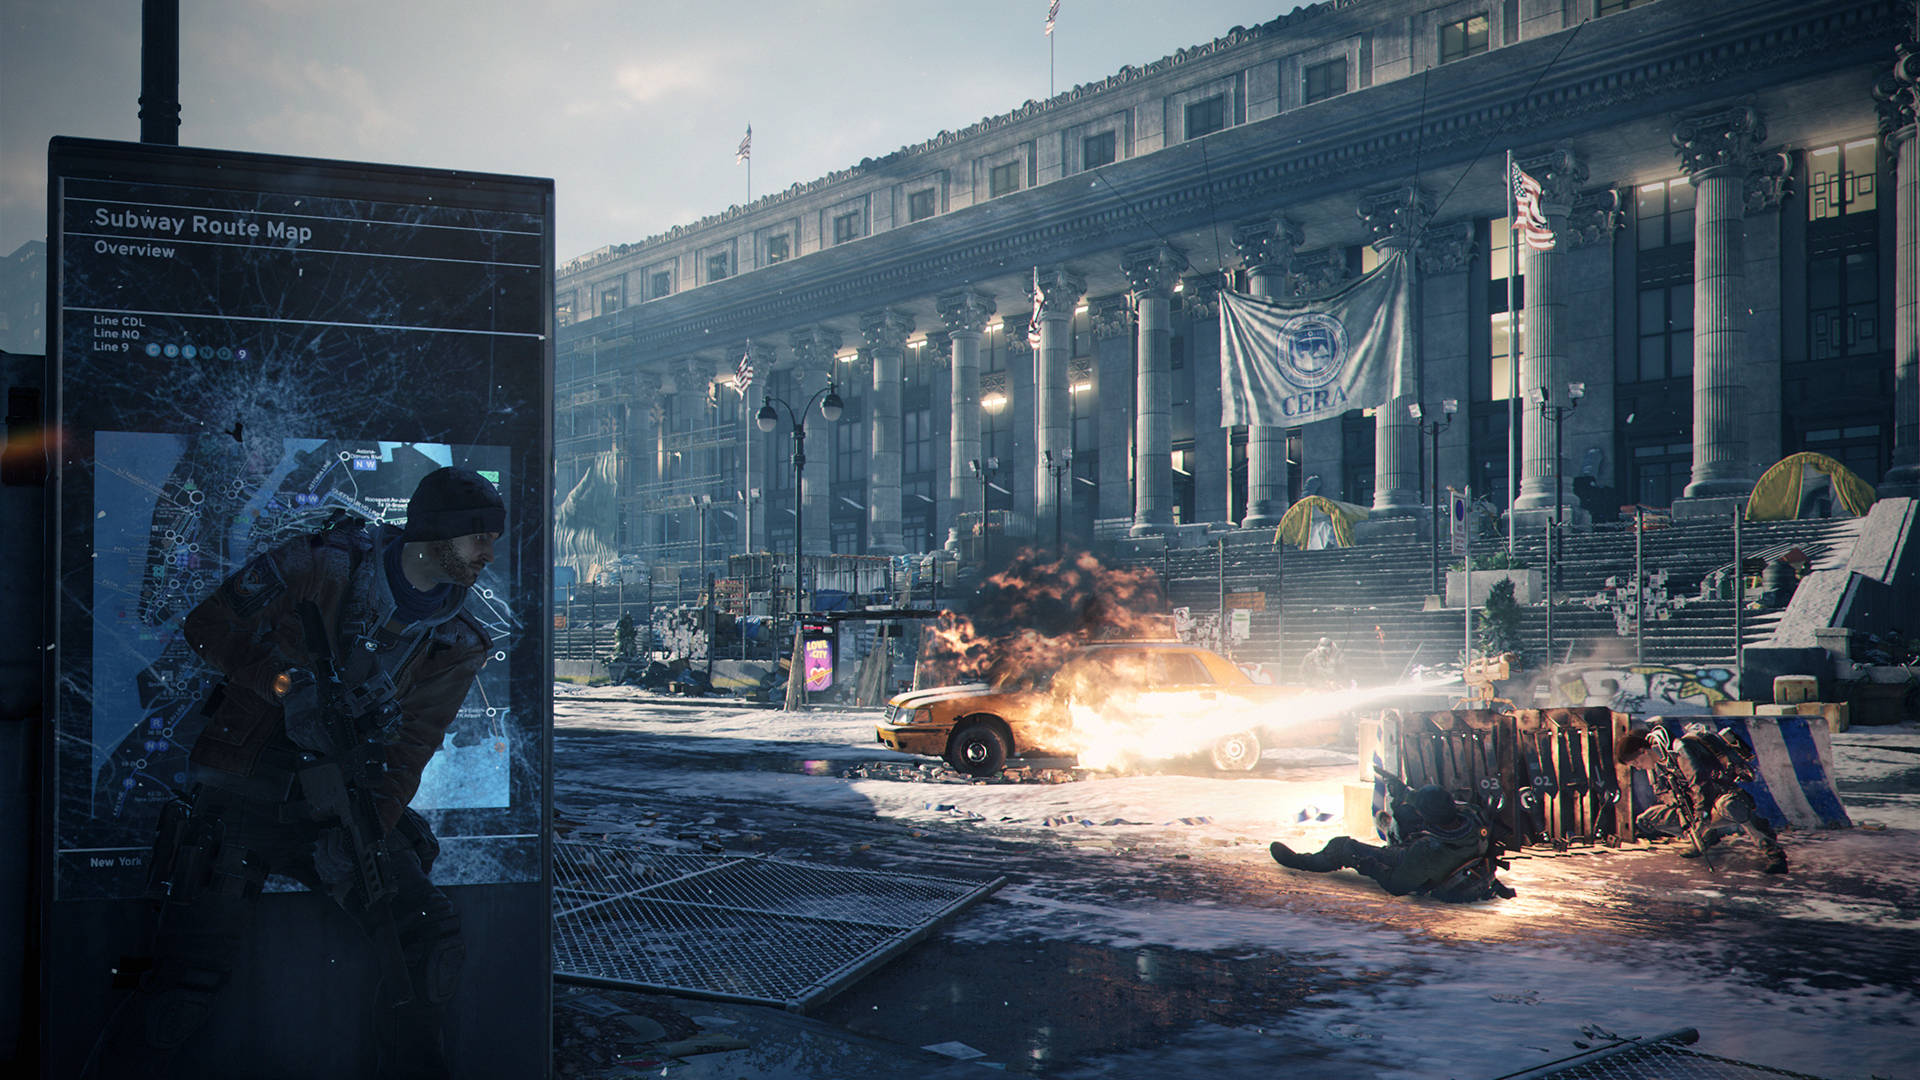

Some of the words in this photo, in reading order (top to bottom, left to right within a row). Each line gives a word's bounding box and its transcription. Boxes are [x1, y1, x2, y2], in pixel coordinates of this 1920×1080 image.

[95, 207, 185, 236] Subway
[192, 214, 260, 237] Route
[266, 220, 312, 244] Map
[94, 239, 176, 258] Overview
[93, 315, 119, 326] Line
[121, 316, 146, 328] CDL
[93, 328, 119, 339] Line
[93, 341, 119, 352] Line
[121, 342, 130, 352] 9
[1282, 385, 1348, 416] CERA
[806, 639, 828, 651] LOVE
[812, 650, 827, 659] CITY
[1480, 777, 1500, 790] 03
[1533, 775, 1553, 786] 02
[90, 856, 114, 868] New
[119, 856, 142, 866] York
